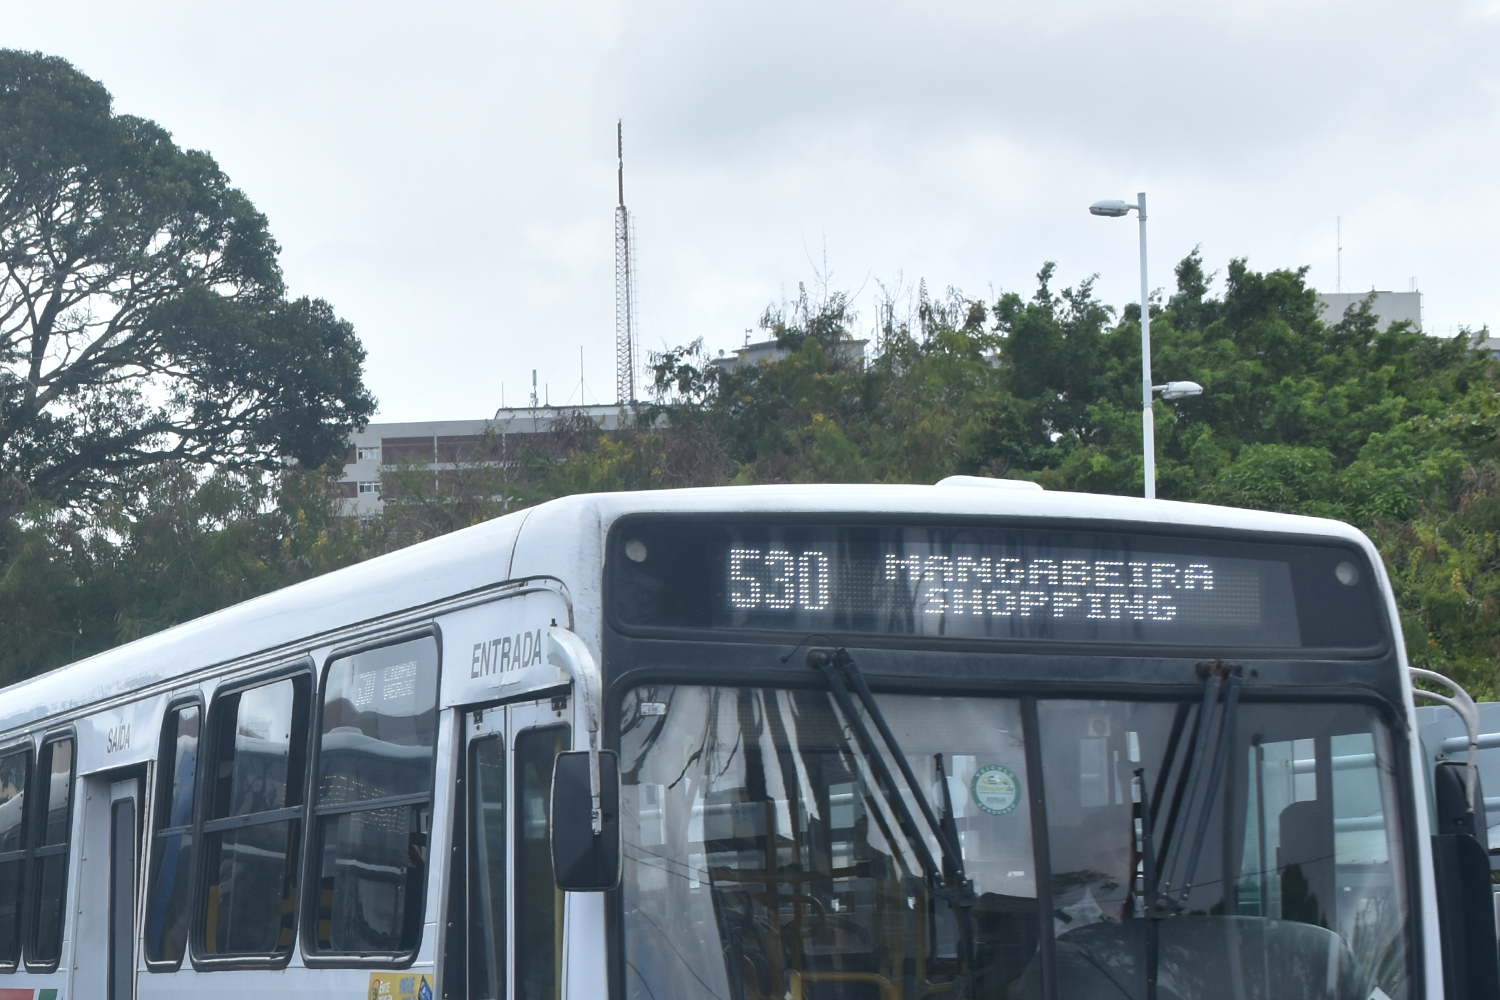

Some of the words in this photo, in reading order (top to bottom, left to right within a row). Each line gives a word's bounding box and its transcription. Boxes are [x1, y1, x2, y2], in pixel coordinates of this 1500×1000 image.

[730, 549, 828, 610] 530
[885, 554, 1214, 590] MANGABEIRA
[924, 587, 1177, 620] SHOPPING
[470, 629, 542, 679] ENTRADA
[106, 717, 131, 754] SAÍDA
